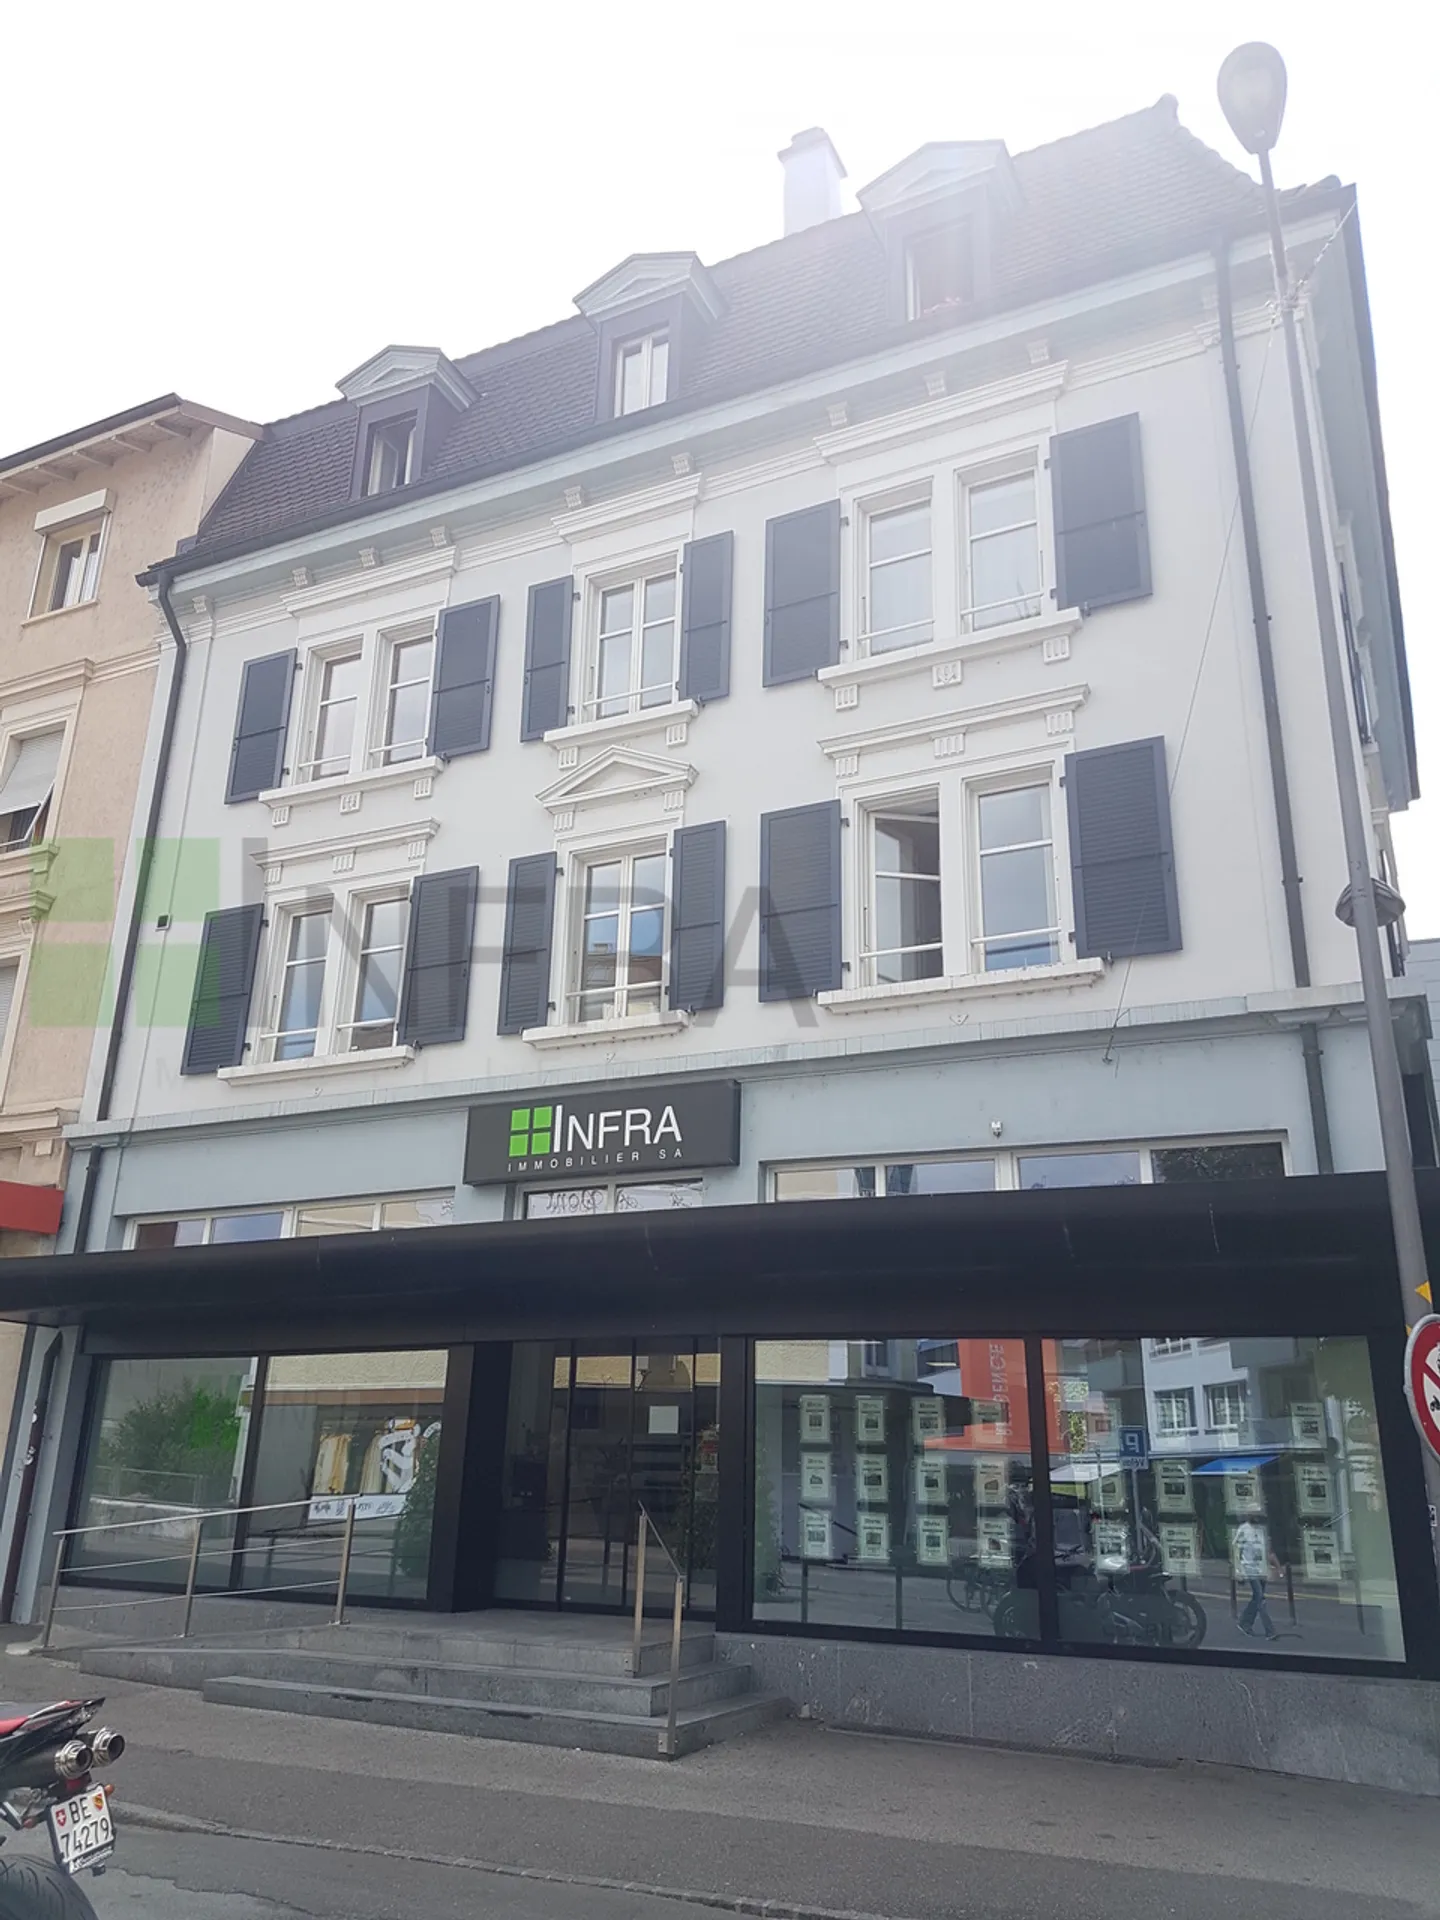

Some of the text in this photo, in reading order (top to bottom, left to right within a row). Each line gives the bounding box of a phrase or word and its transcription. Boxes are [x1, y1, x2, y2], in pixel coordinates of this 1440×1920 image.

[553, 1105, 683, 1153] INFRA
[507, 1148, 683, 1173] IMMOBILIER SA
[68, 1797, 92, 1824] BE
[60, 1817, 109, 1857] 74279
